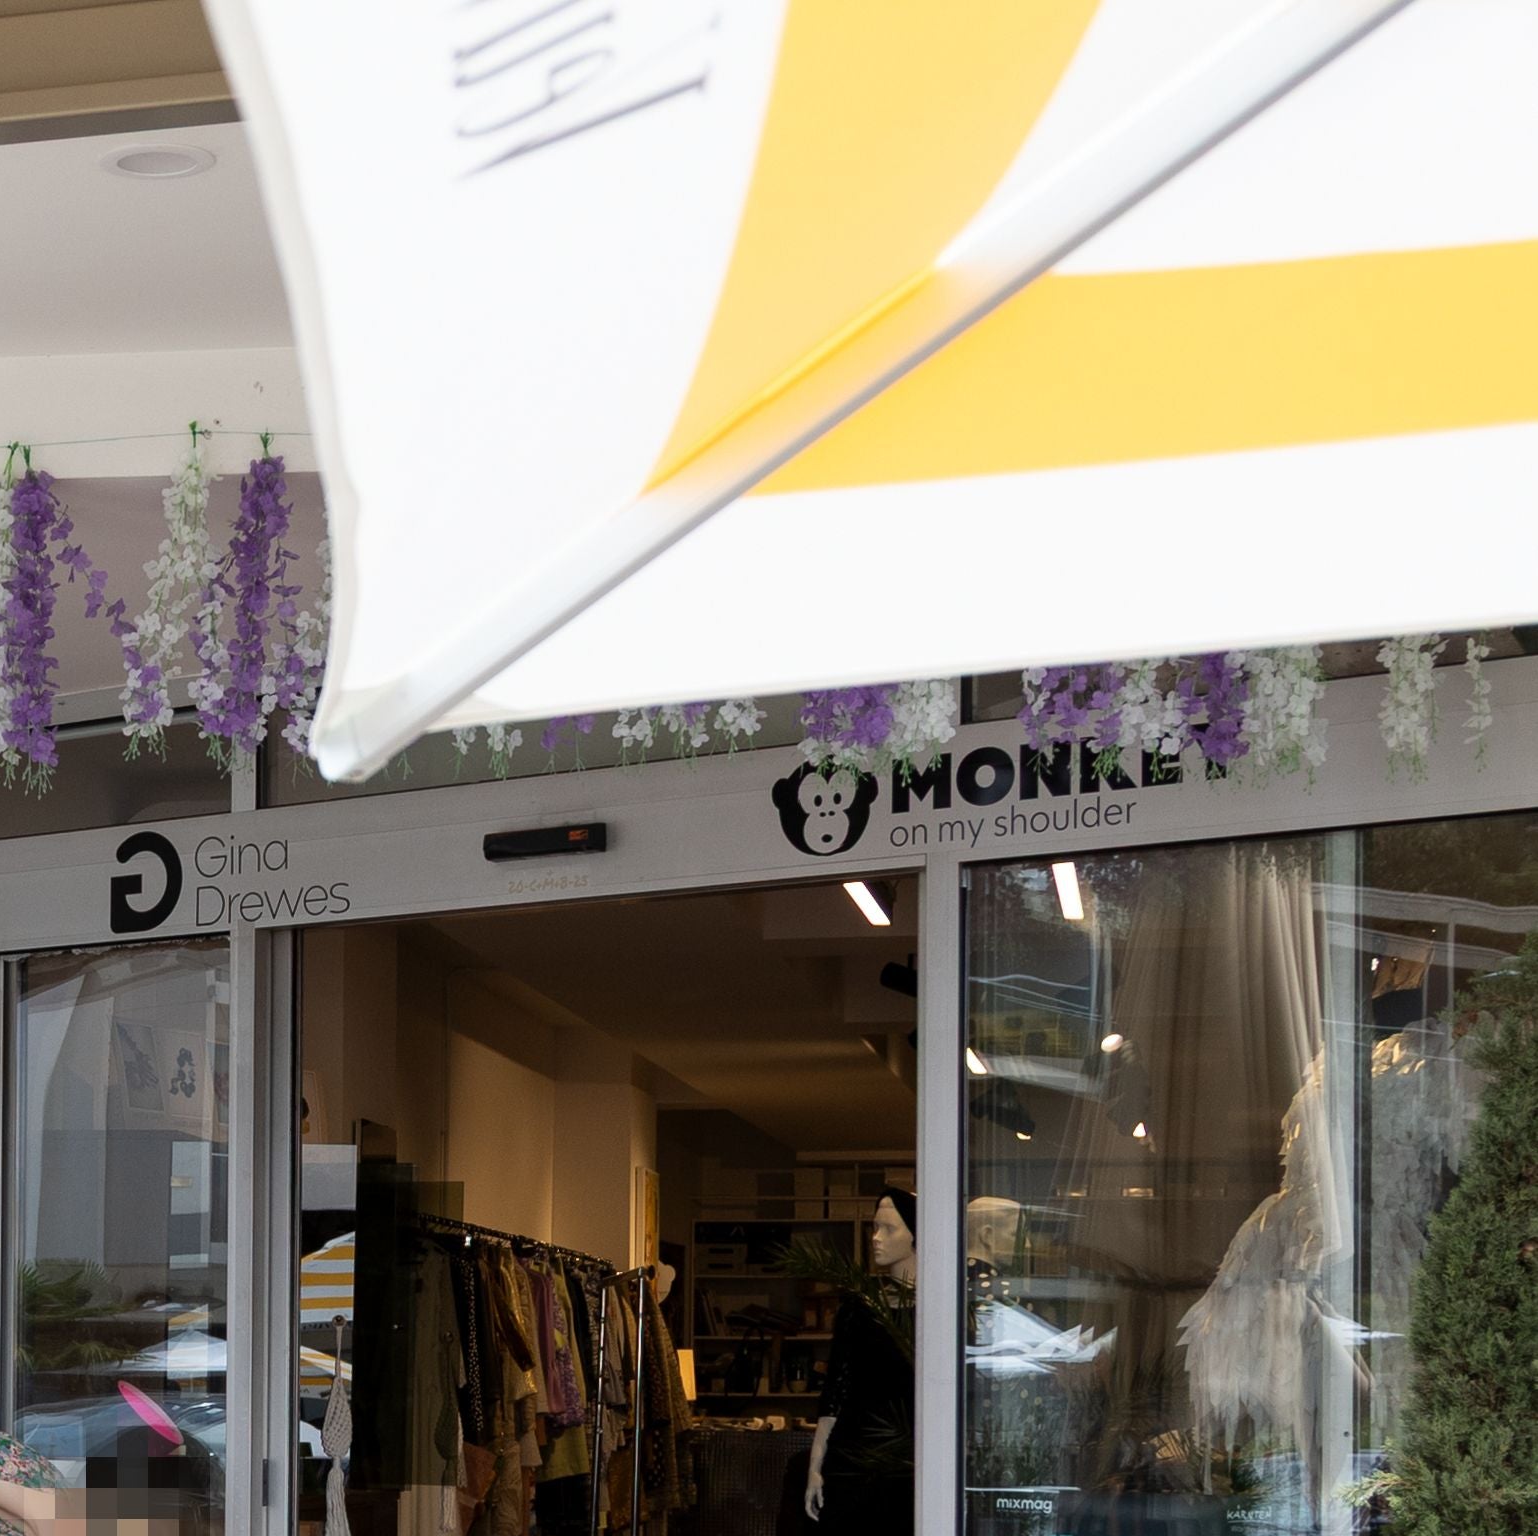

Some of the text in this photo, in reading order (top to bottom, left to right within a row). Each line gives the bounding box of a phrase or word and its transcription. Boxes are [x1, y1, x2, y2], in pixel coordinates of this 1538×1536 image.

[889, 796, 1138, 848] on my shoulder
[194, 834, 289, 878] Gina
[195, 882, 351, 927] Drewes
[996, 1497, 1053, 1514] mixmag
